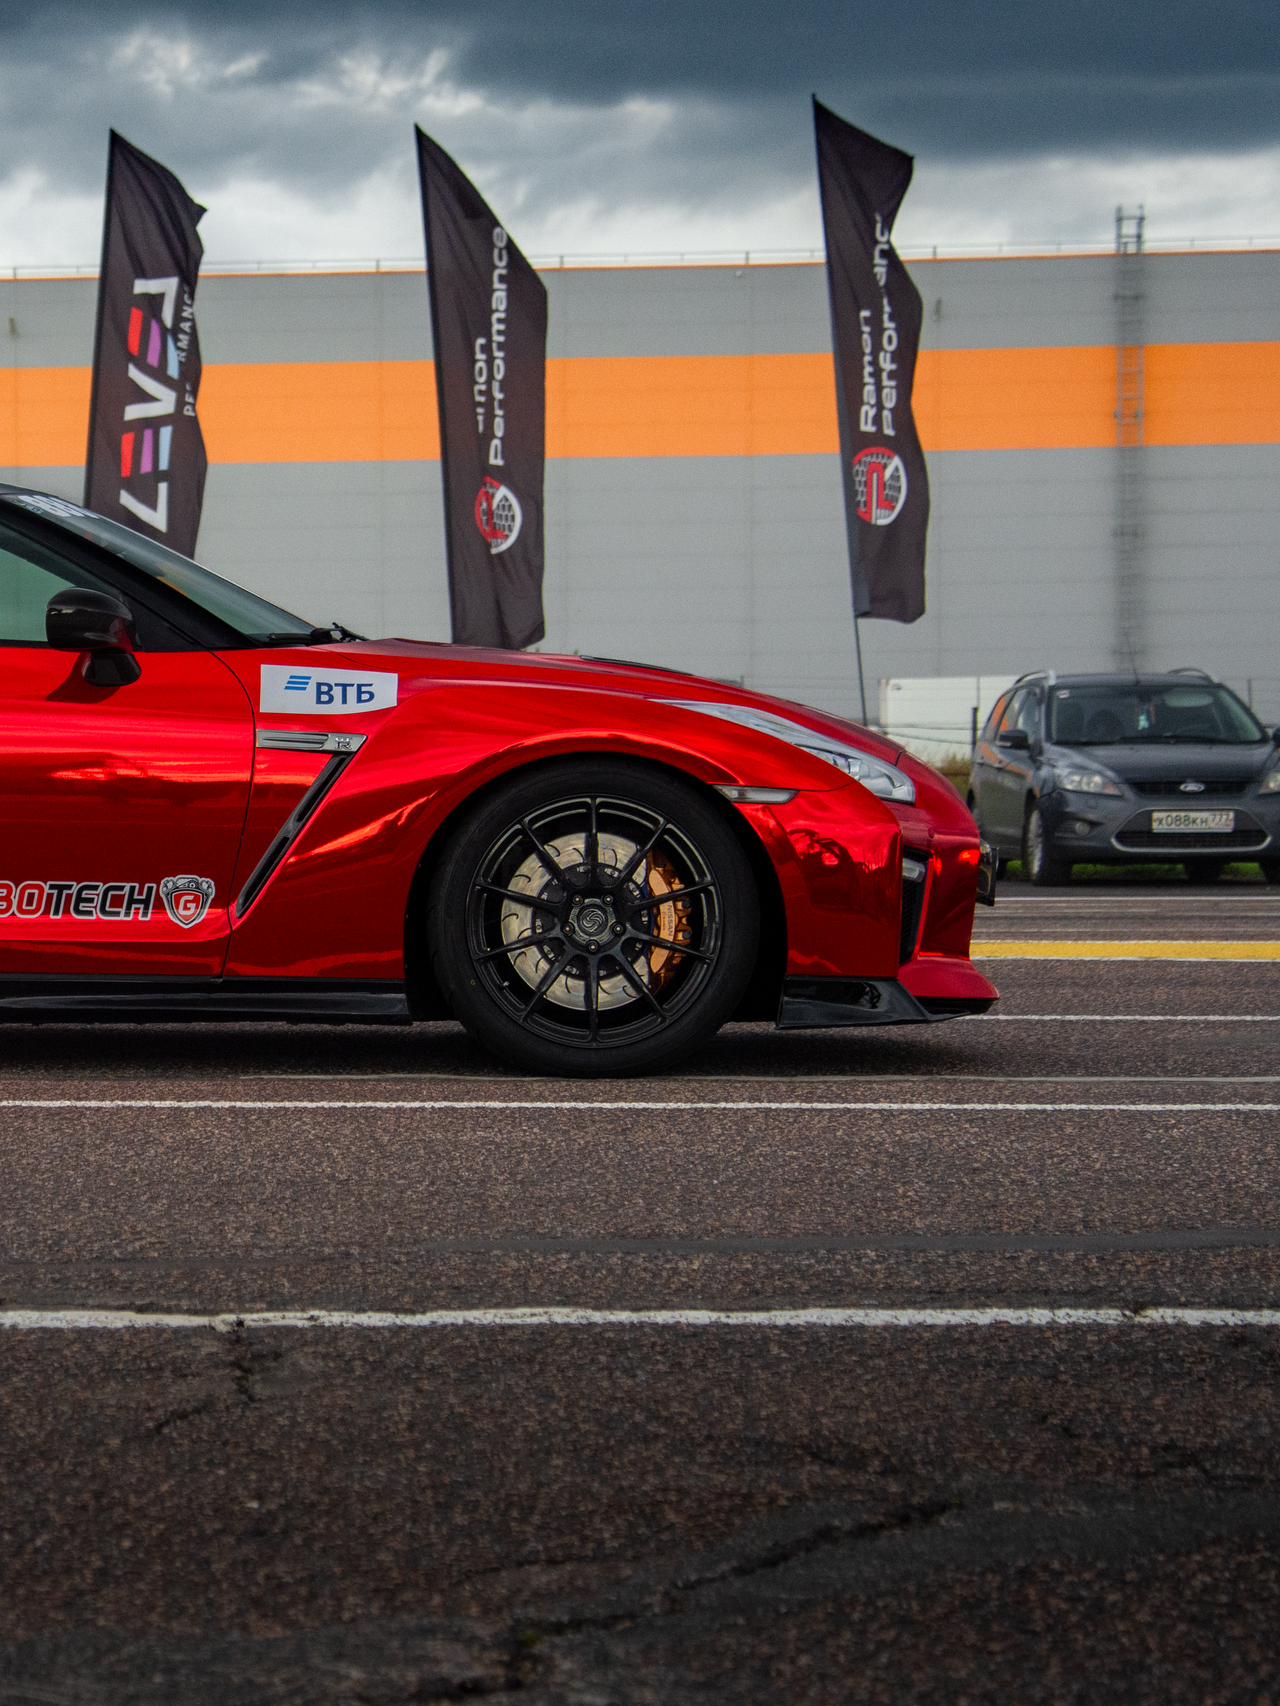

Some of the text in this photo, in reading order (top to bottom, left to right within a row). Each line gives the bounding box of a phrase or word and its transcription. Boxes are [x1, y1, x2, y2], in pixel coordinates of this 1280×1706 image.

[119, 276, 180, 533] LEVEL
[488, 226, 508, 466] Performance
[858, 309, 878, 433] Ramon
[315, 682, 375, 705] ВТБ
[179, 895, 196, 915] G
